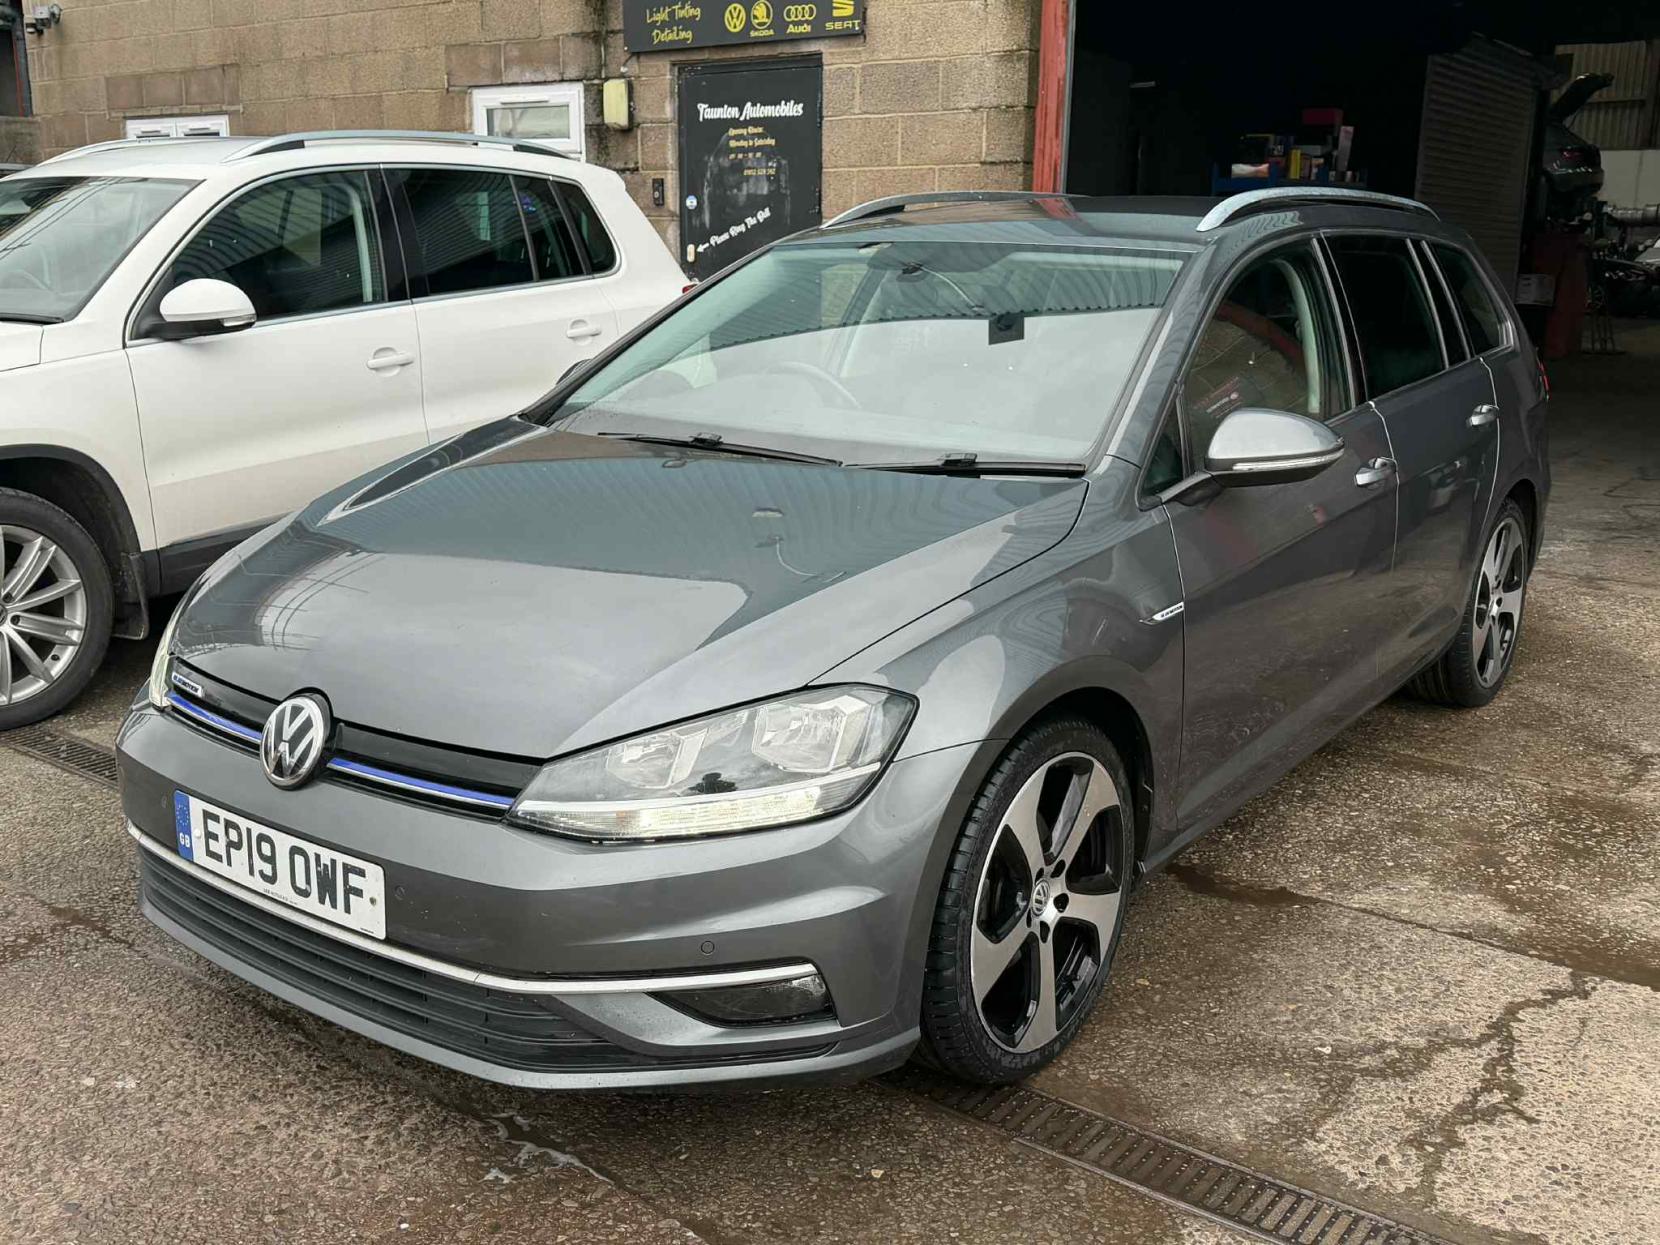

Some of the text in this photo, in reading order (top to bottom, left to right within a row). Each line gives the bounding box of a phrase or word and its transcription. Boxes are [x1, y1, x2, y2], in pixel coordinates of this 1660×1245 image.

[646, 1, 701, 26] Light Tinting
[652, 25, 693, 45] Detailing
[786, 23, 811, 33] Audi
[825, 20, 861, 31] SEAT
[697, 99, 804, 122] Taunton Automobiles
[179, 832, 191, 848] GB
[202, 808, 367, 915] EP19 OWF
